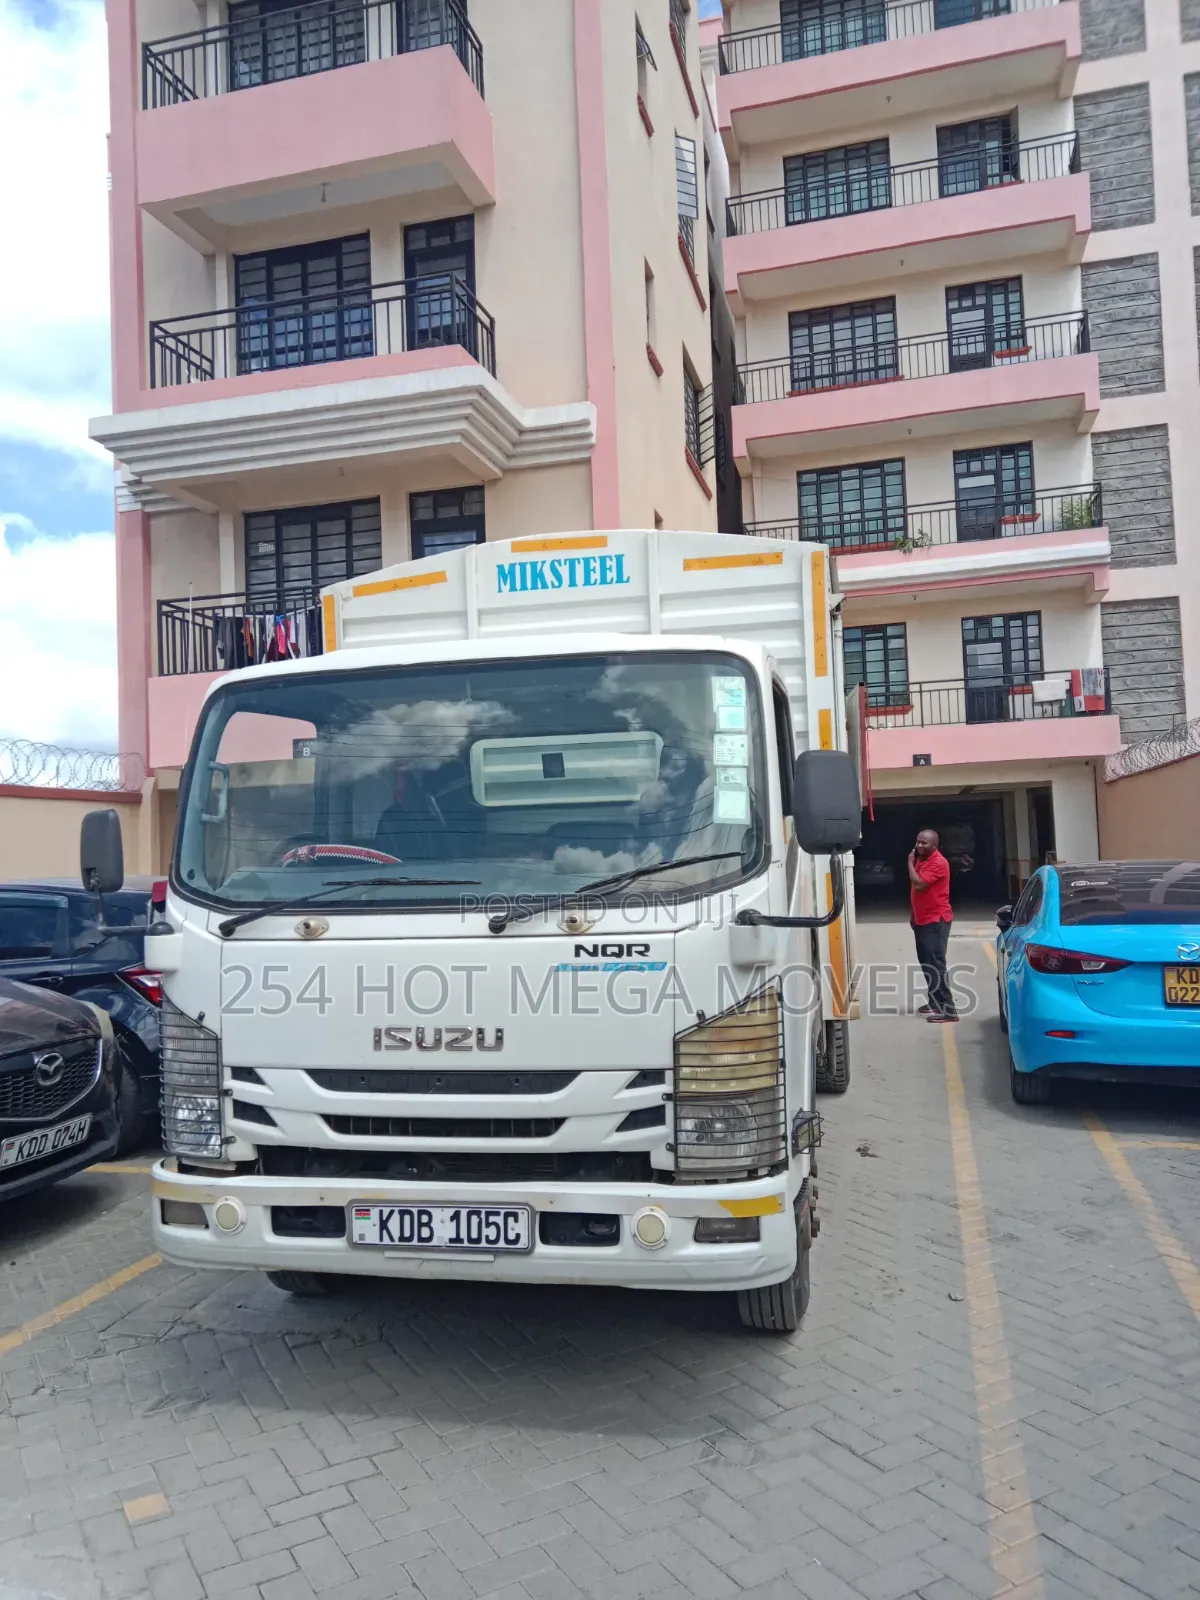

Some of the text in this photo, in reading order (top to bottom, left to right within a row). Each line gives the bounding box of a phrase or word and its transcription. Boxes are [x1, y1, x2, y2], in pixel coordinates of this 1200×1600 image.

[496, 553, 631, 593] MIKSTEEL
[574, 943, 651, 958] NQR
[372, 1025, 505, 1052] ISUZU
[15, 1119, 87, 1162] KDD 074H
[378, 1208, 521, 1246] KDB 105C
